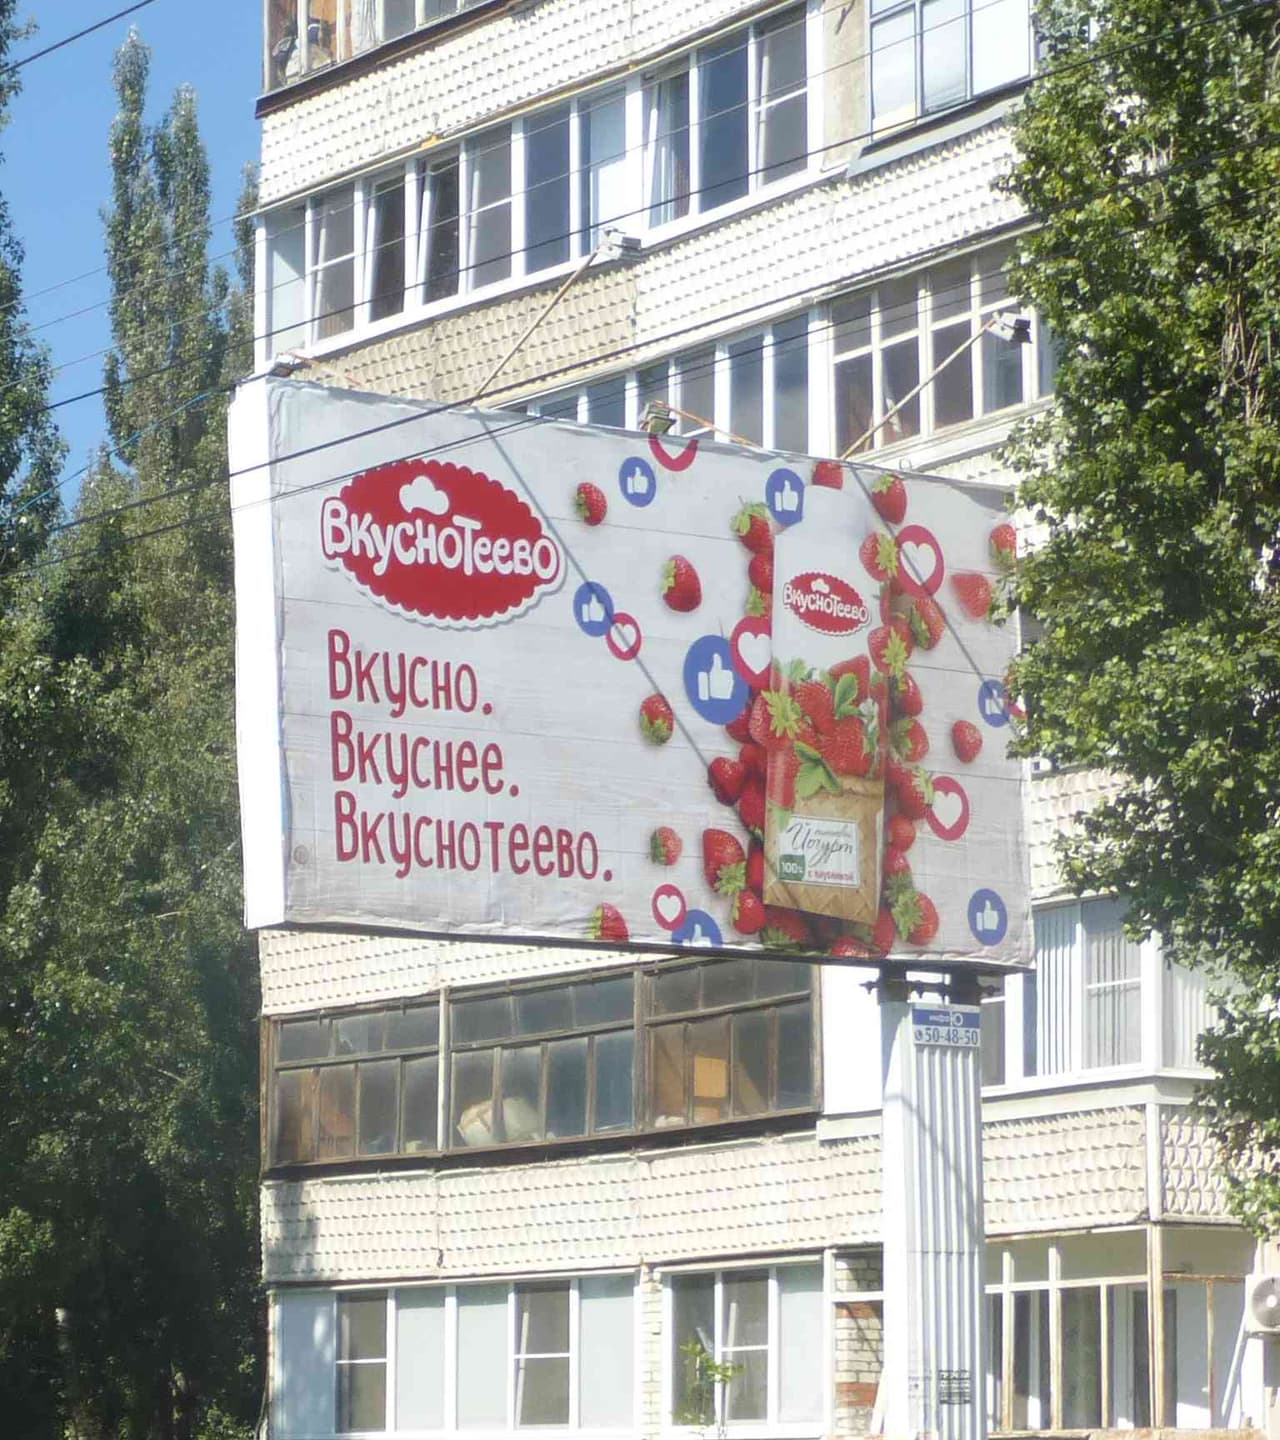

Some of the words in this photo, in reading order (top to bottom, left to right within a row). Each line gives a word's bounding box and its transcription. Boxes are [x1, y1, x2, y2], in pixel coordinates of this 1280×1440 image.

[328, 629, 493, 715] Вкусно.
[331, 710, 520, 798] Вкуснее.
[335, 791, 613, 882] Вкуснотеево.
[924, 1027, 978, 1045] 50-48-50
